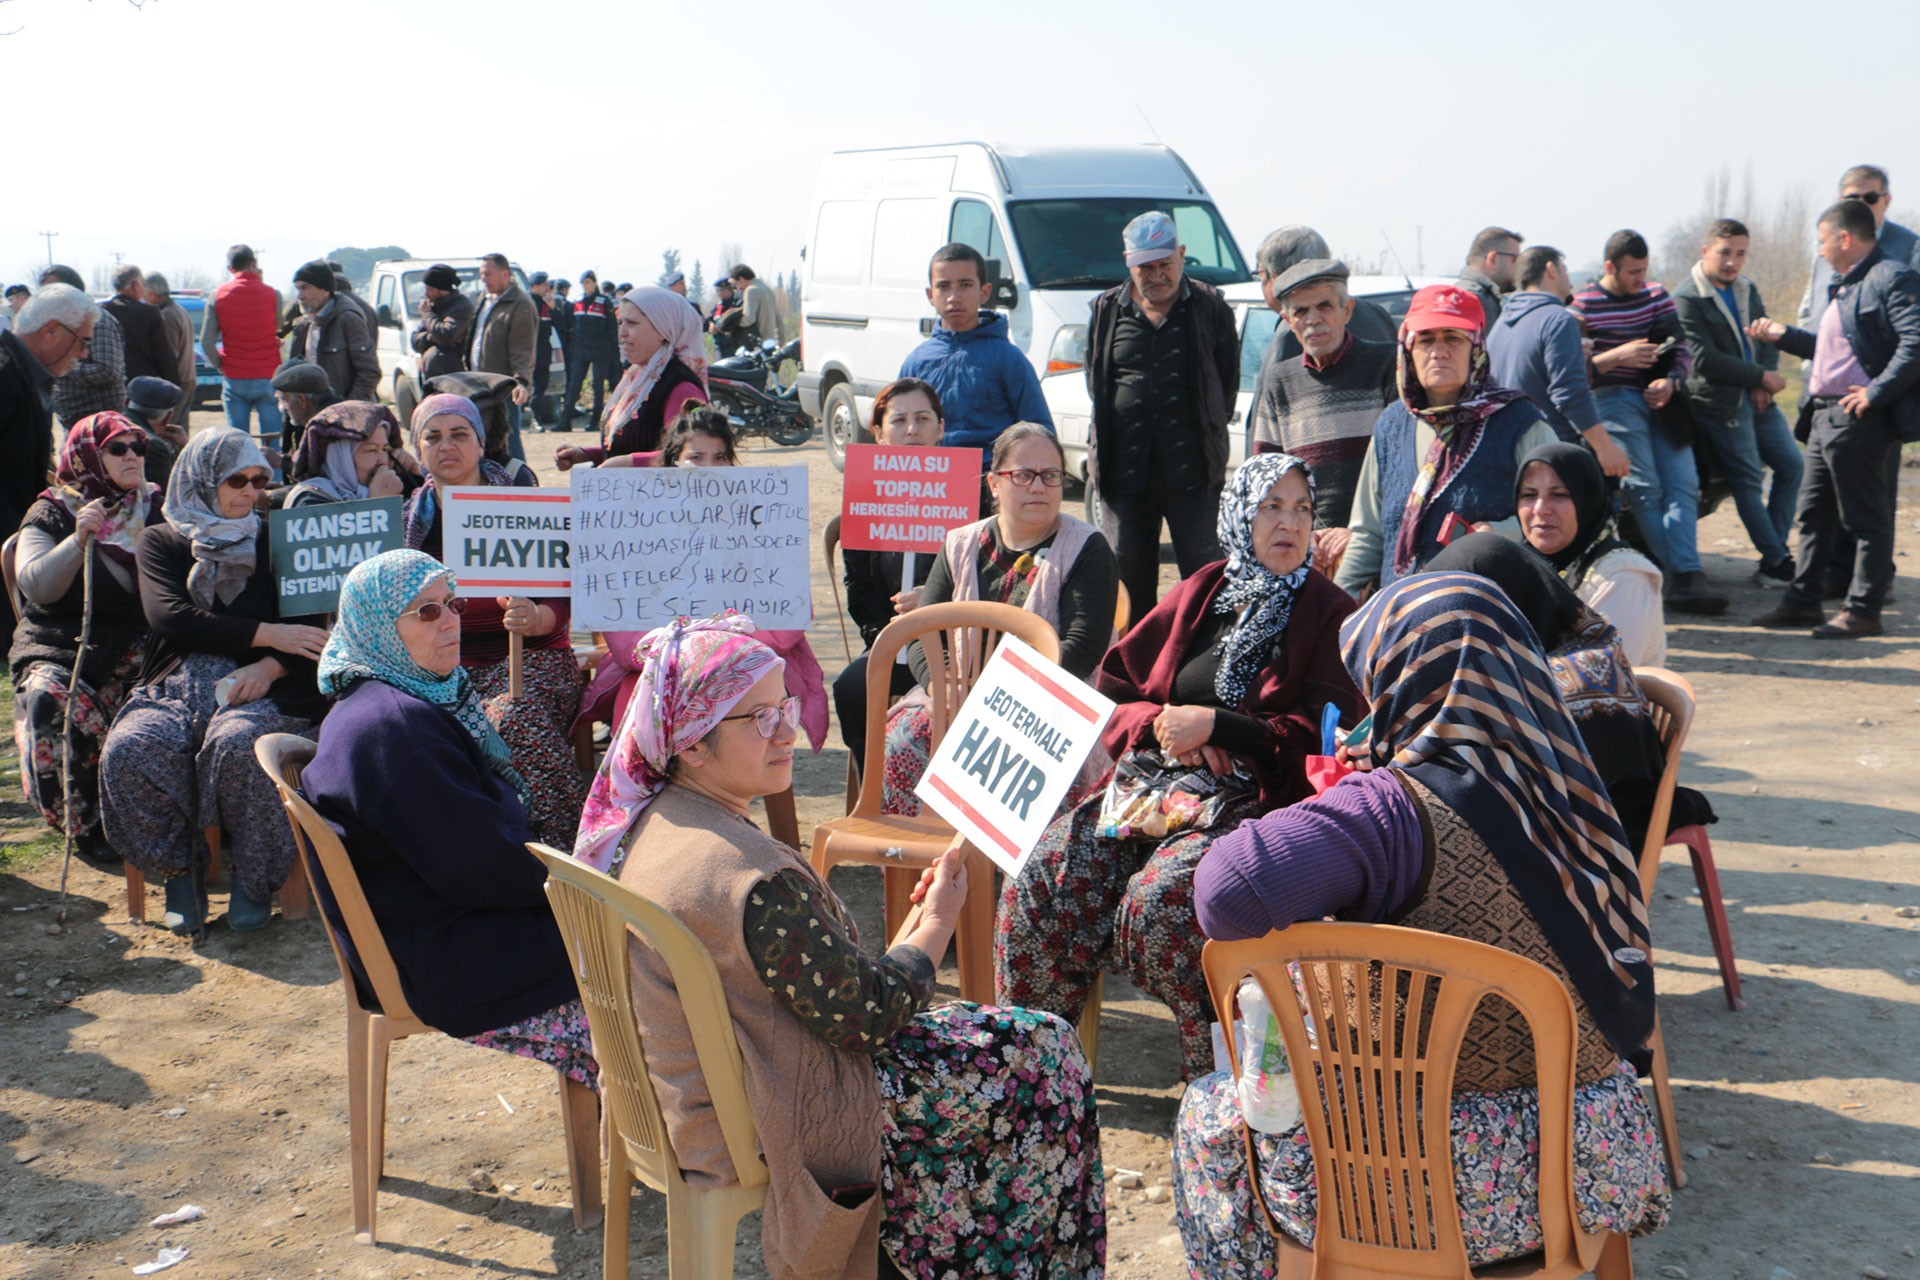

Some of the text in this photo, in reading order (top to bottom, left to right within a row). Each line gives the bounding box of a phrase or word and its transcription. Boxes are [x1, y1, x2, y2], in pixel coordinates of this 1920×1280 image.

[873, 454, 950, 473] HAVA SU
[873, 480, 947, 498] TOPRAK
[849, 501, 969, 520] HERKESİN ORTAK
[286, 509, 389, 542] KANSER
[461, 514, 571, 531] JEOTERMALE
[869, 523, 946, 542] MALIDIR
[293, 540, 382, 573] OLMAK
[464, 537, 570, 569] HAYIR
[723, 598, 794, 617] HAYIR
[983, 686, 1073, 763] JEOTERMALE
[951, 718, 1047, 822] HAYIR
